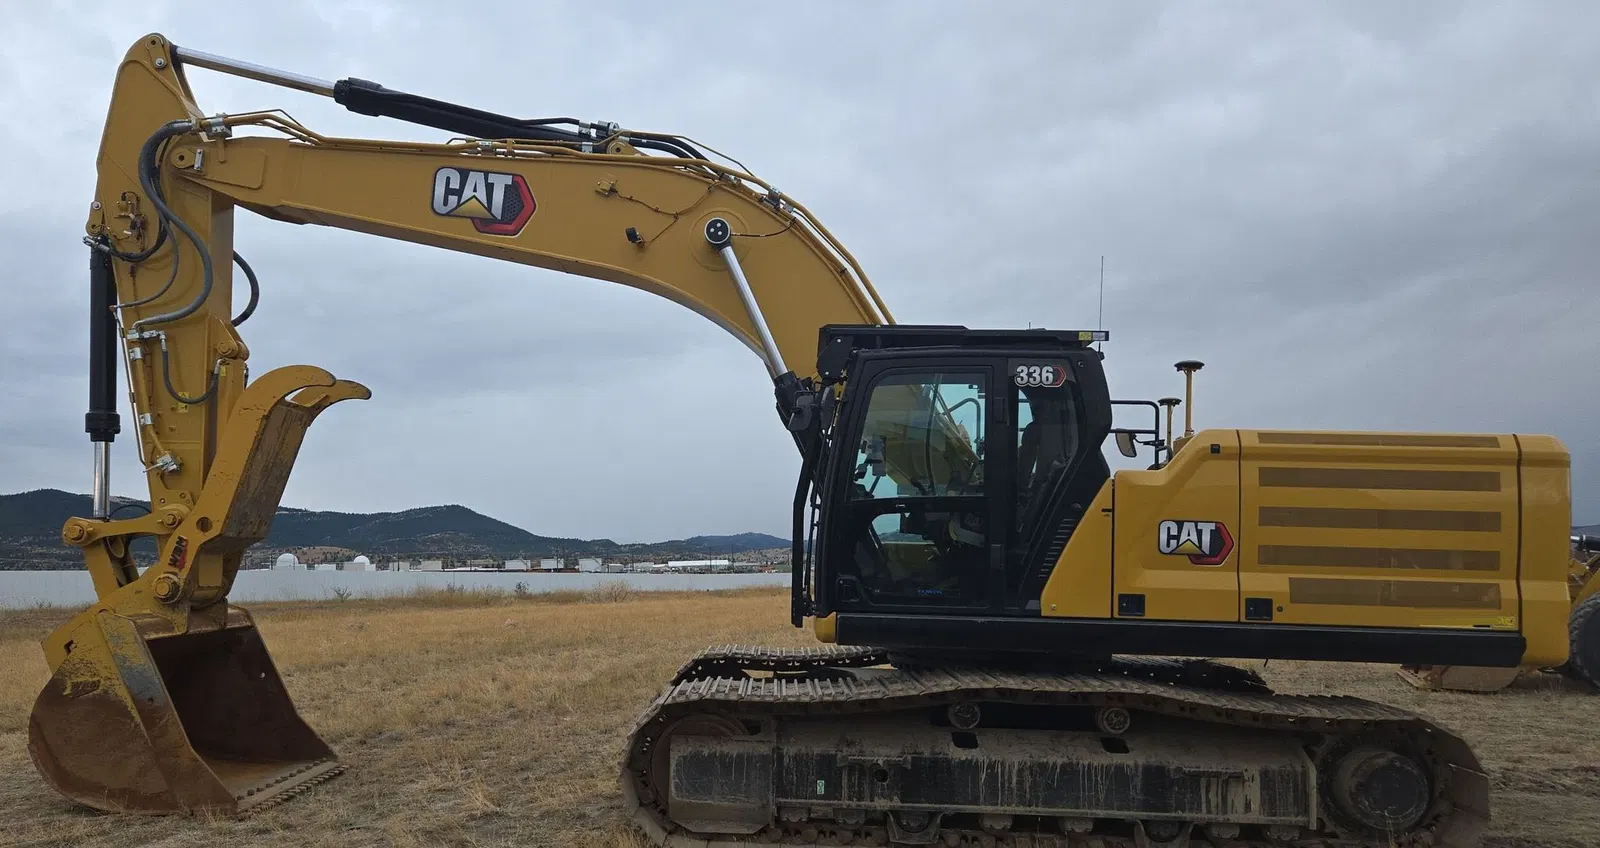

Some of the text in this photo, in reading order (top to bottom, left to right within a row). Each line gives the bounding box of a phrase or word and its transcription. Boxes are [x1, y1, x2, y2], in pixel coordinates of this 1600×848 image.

[433, 168, 513, 220] CAT
[1016, 365, 1054, 385] 336
[1160, 521, 1215, 555] CAT
